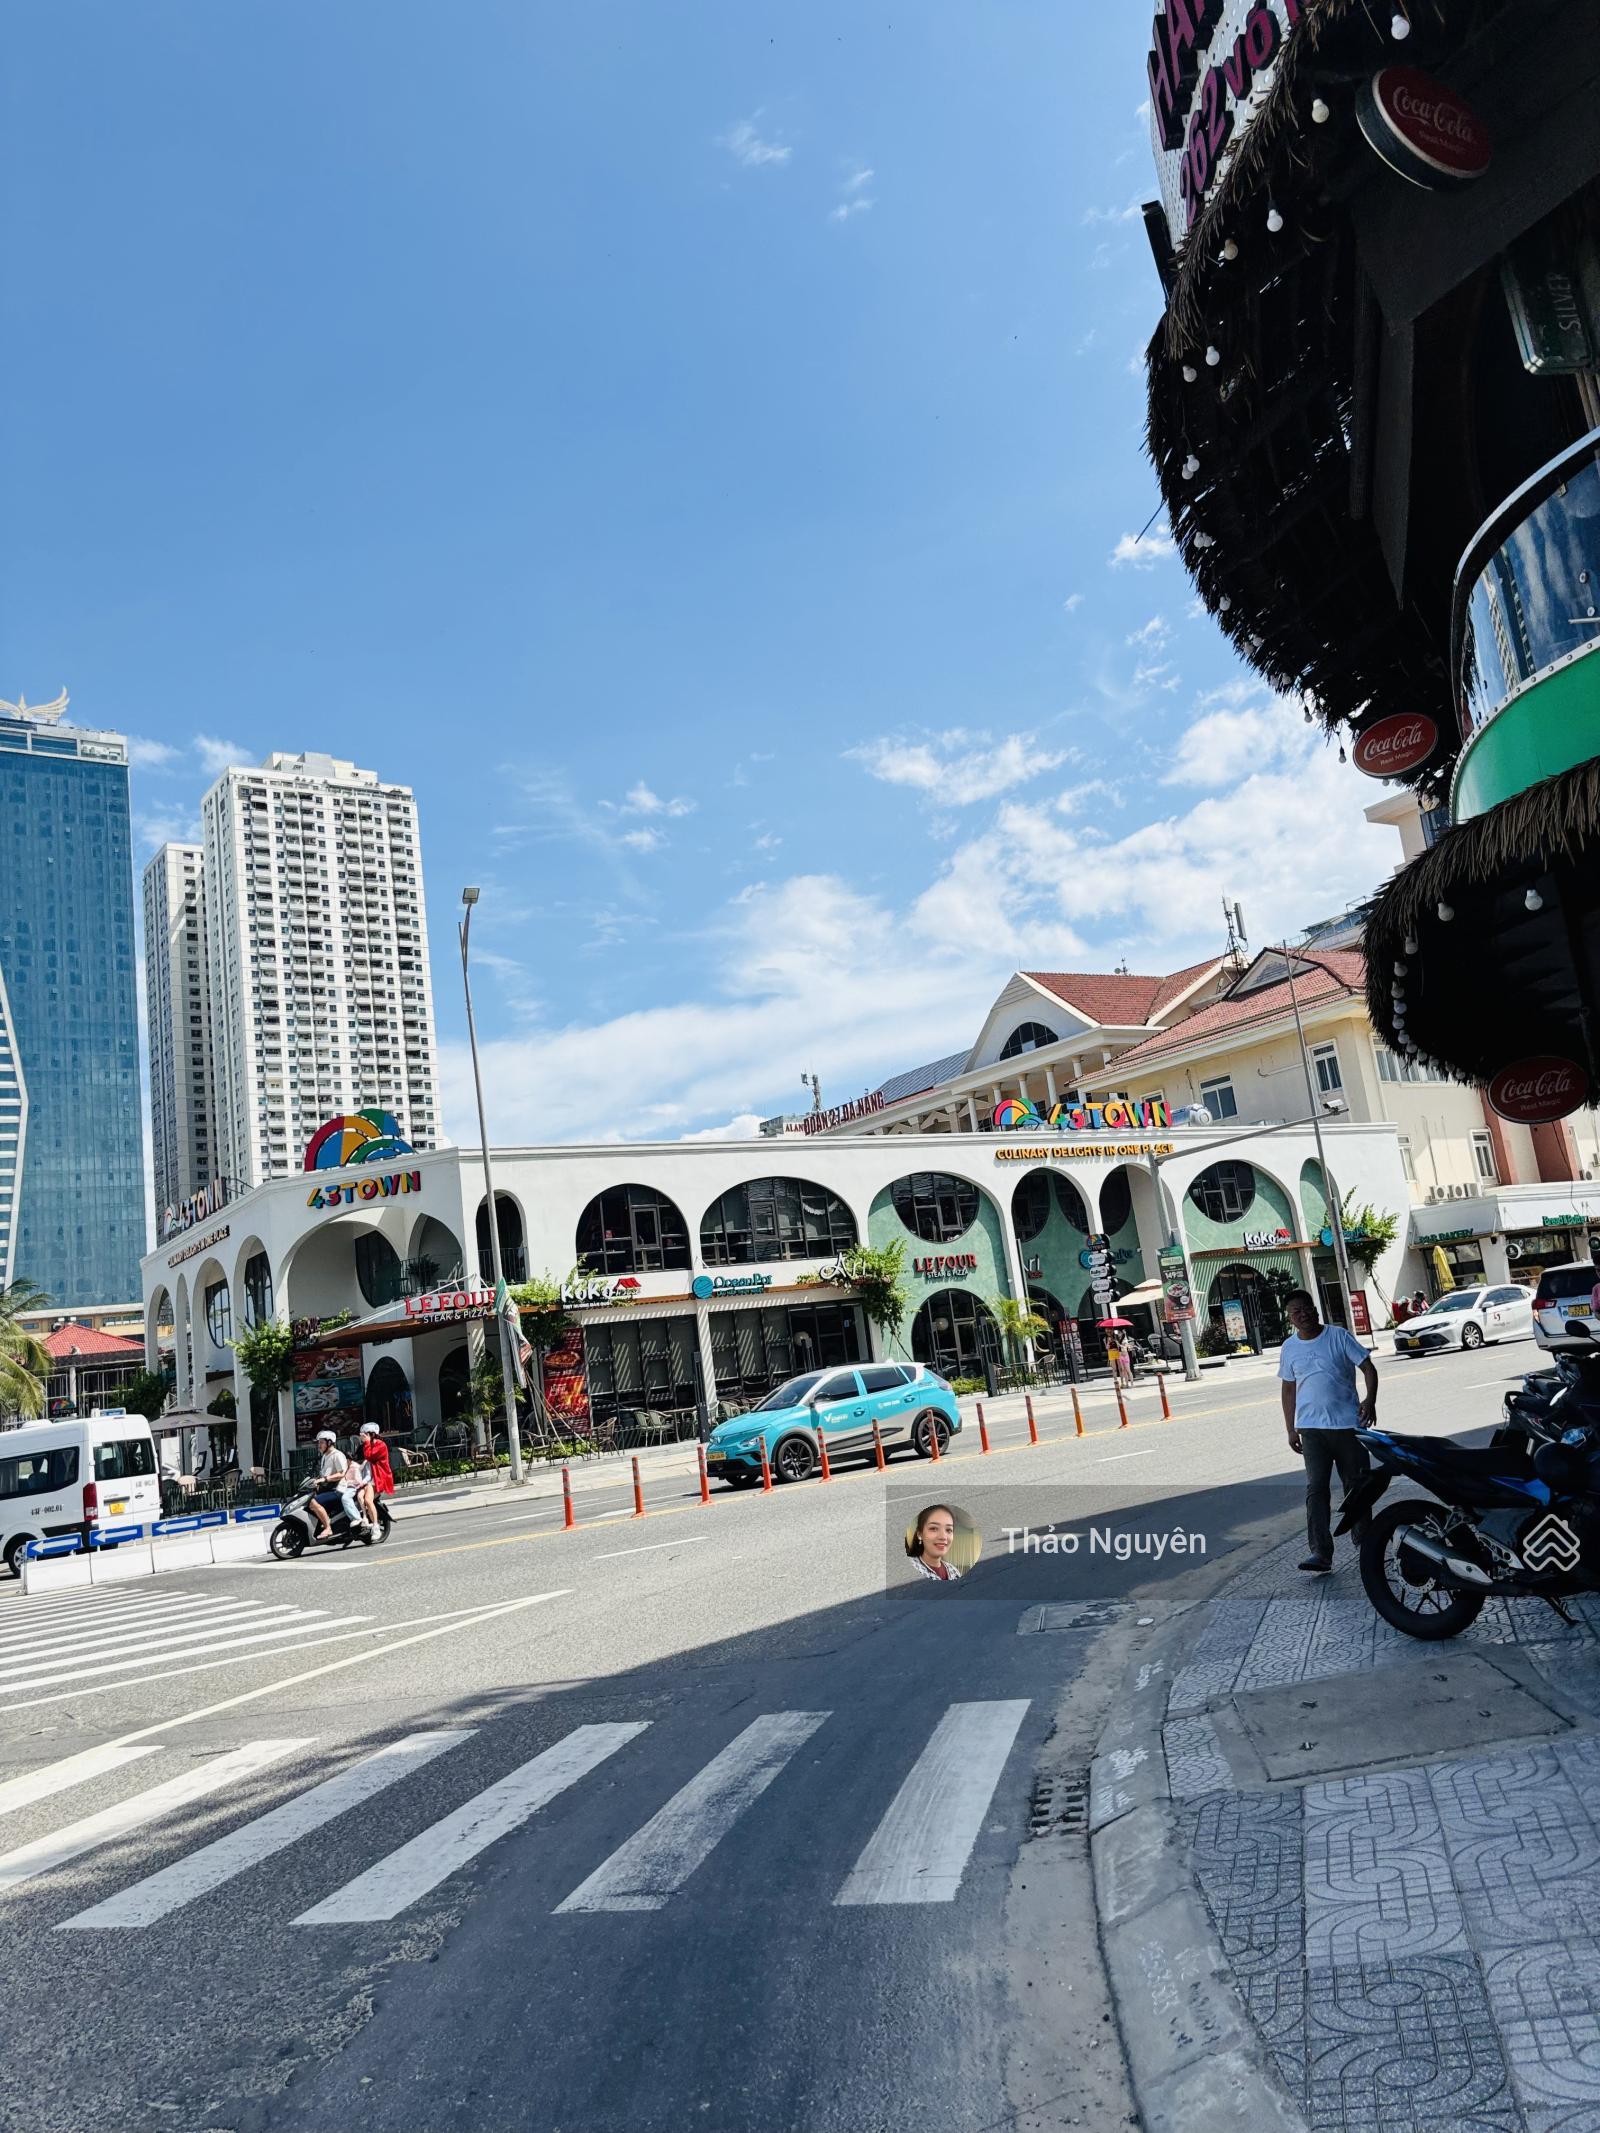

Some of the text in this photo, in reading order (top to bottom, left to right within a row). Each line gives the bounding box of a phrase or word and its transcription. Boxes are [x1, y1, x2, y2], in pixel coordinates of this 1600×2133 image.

[1393, 86, 1478, 143] Coca-Cola
[1363, 721, 1423, 761] Coca-Cola
[1501, 1067, 1573, 1103] Coca-Cola
[1049, 1101, 1172, 1130] 43TOWN
[996, 1143, 1174, 1161] CULINARY DELIGHTS IN ONE PACE
[307, 1170, 421, 1209] 43TOWN
[914, 1253, 977, 1272] LE FOUR
[405, 1296, 434, 1316] LE
[423, 1309, 489, 1324] STEAK & PIZZA
